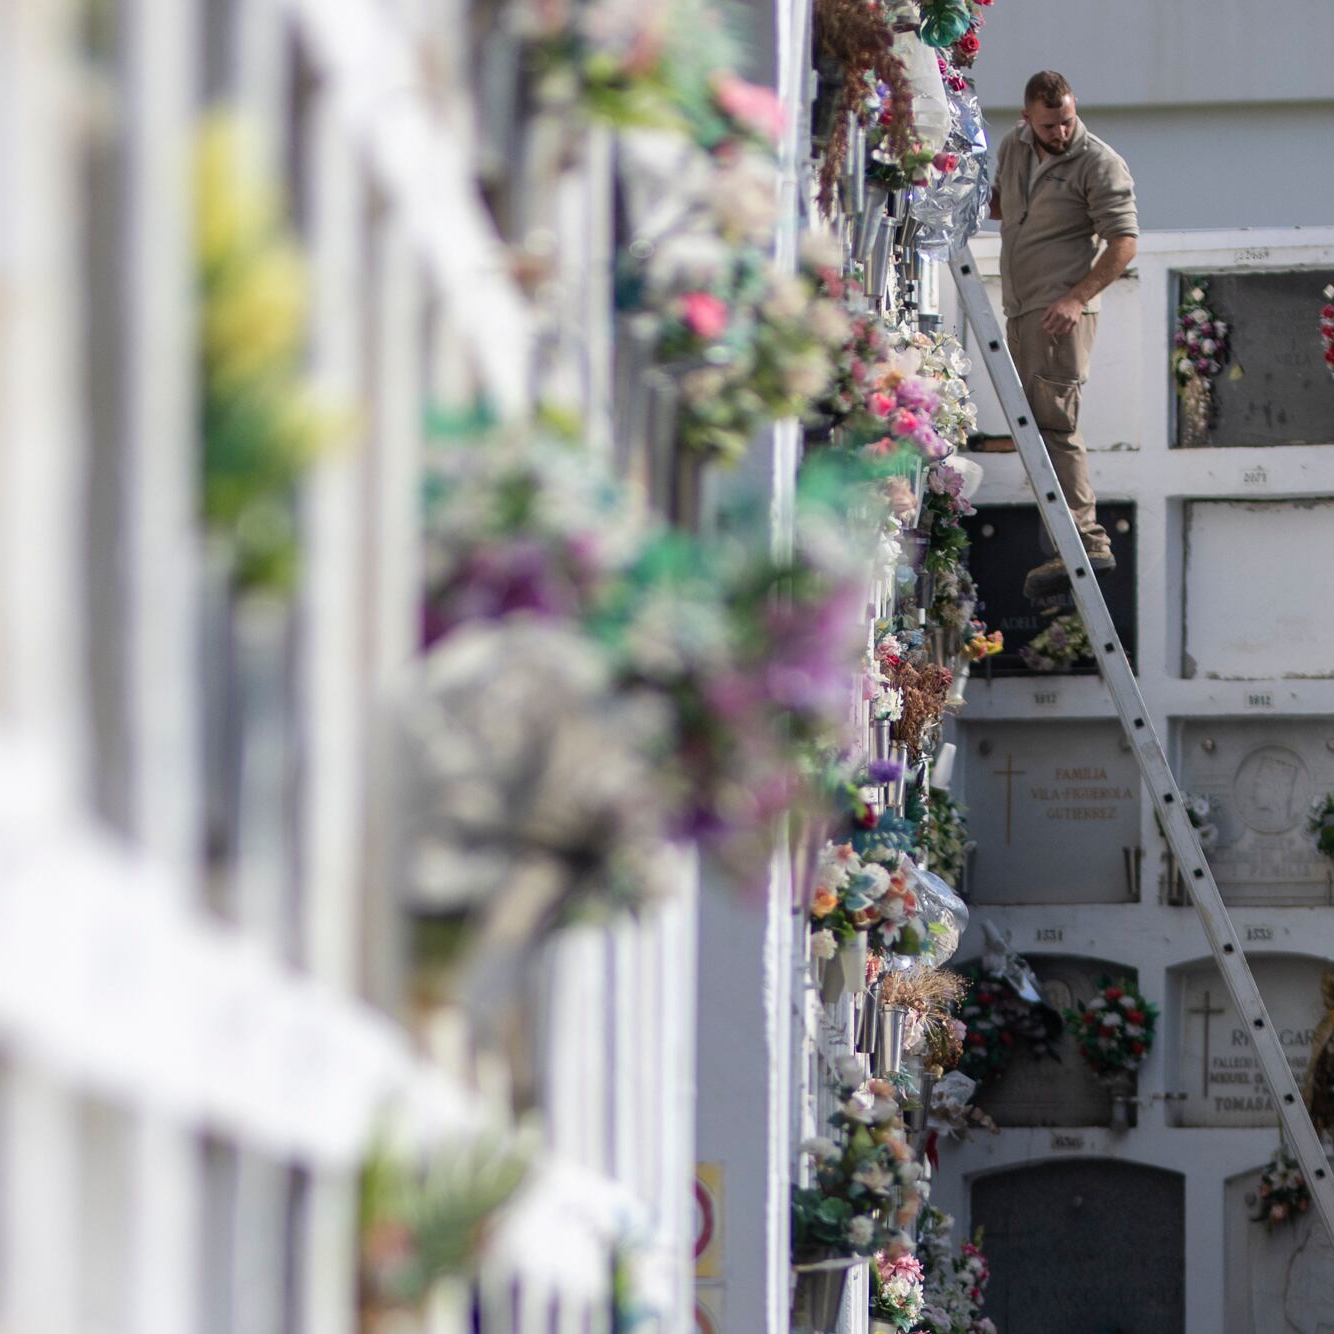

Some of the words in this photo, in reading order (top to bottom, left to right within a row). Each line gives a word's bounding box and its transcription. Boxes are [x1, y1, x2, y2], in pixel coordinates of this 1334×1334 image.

[1055, 767, 1108, 781] FAMILIA
[1046, 806, 1117, 820] GUTIERREZ
[1214, 1096, 1275, 1112] TOMASA
